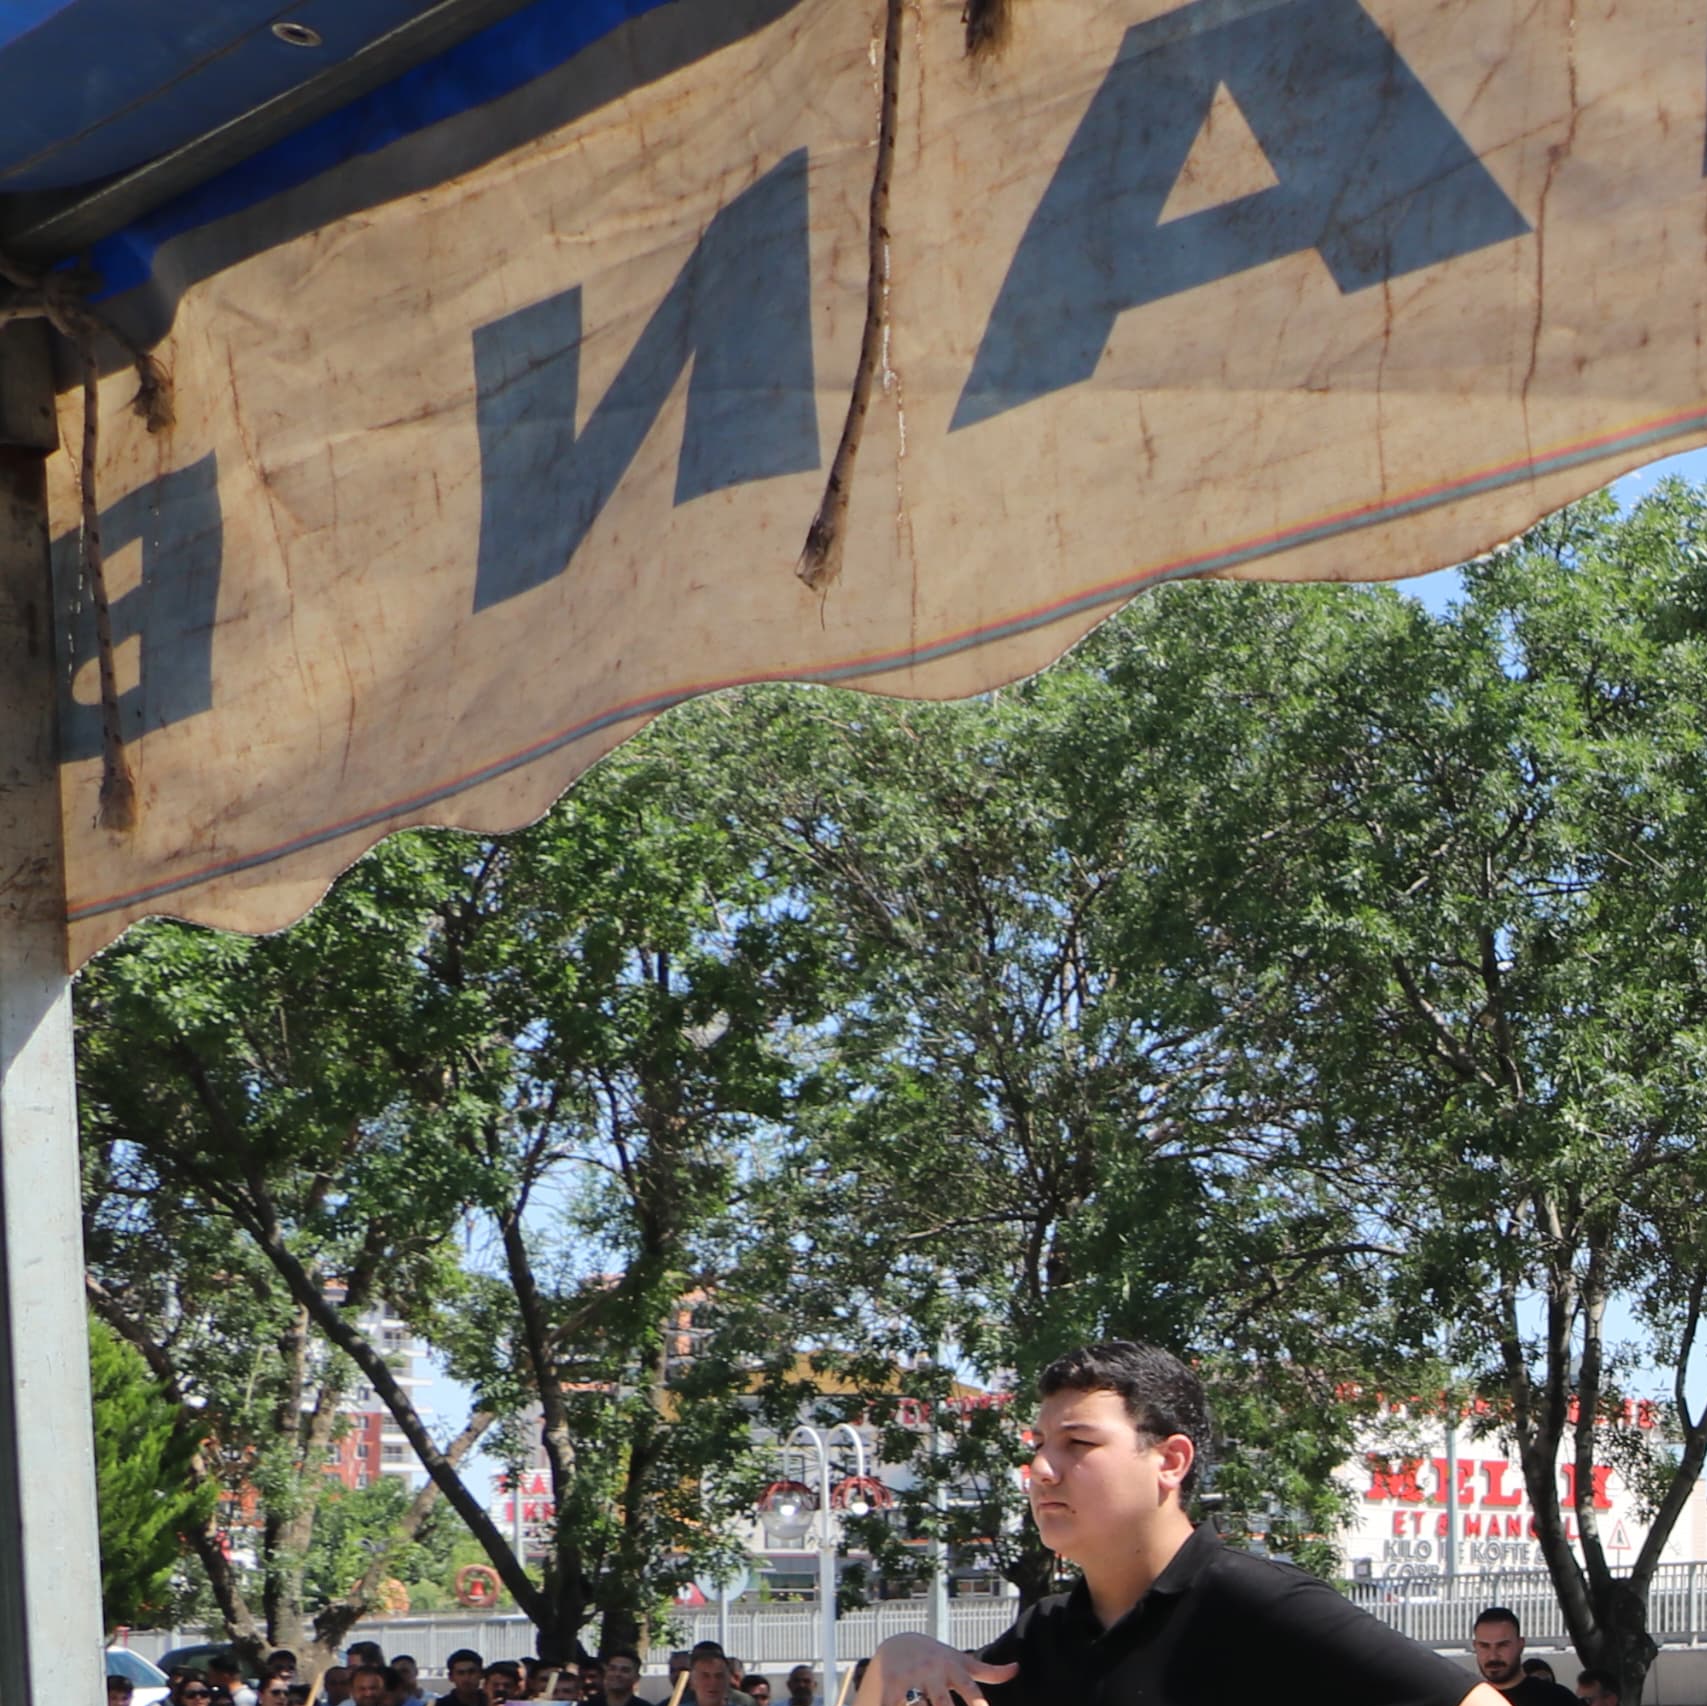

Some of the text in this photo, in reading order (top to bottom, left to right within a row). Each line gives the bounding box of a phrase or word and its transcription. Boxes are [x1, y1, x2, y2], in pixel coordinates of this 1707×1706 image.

[1364, 1452, 1613, 1509] MELH
[1392, 1510, 1427, 1536] ET
[1463, 1513, 1581, 1540] MANL
